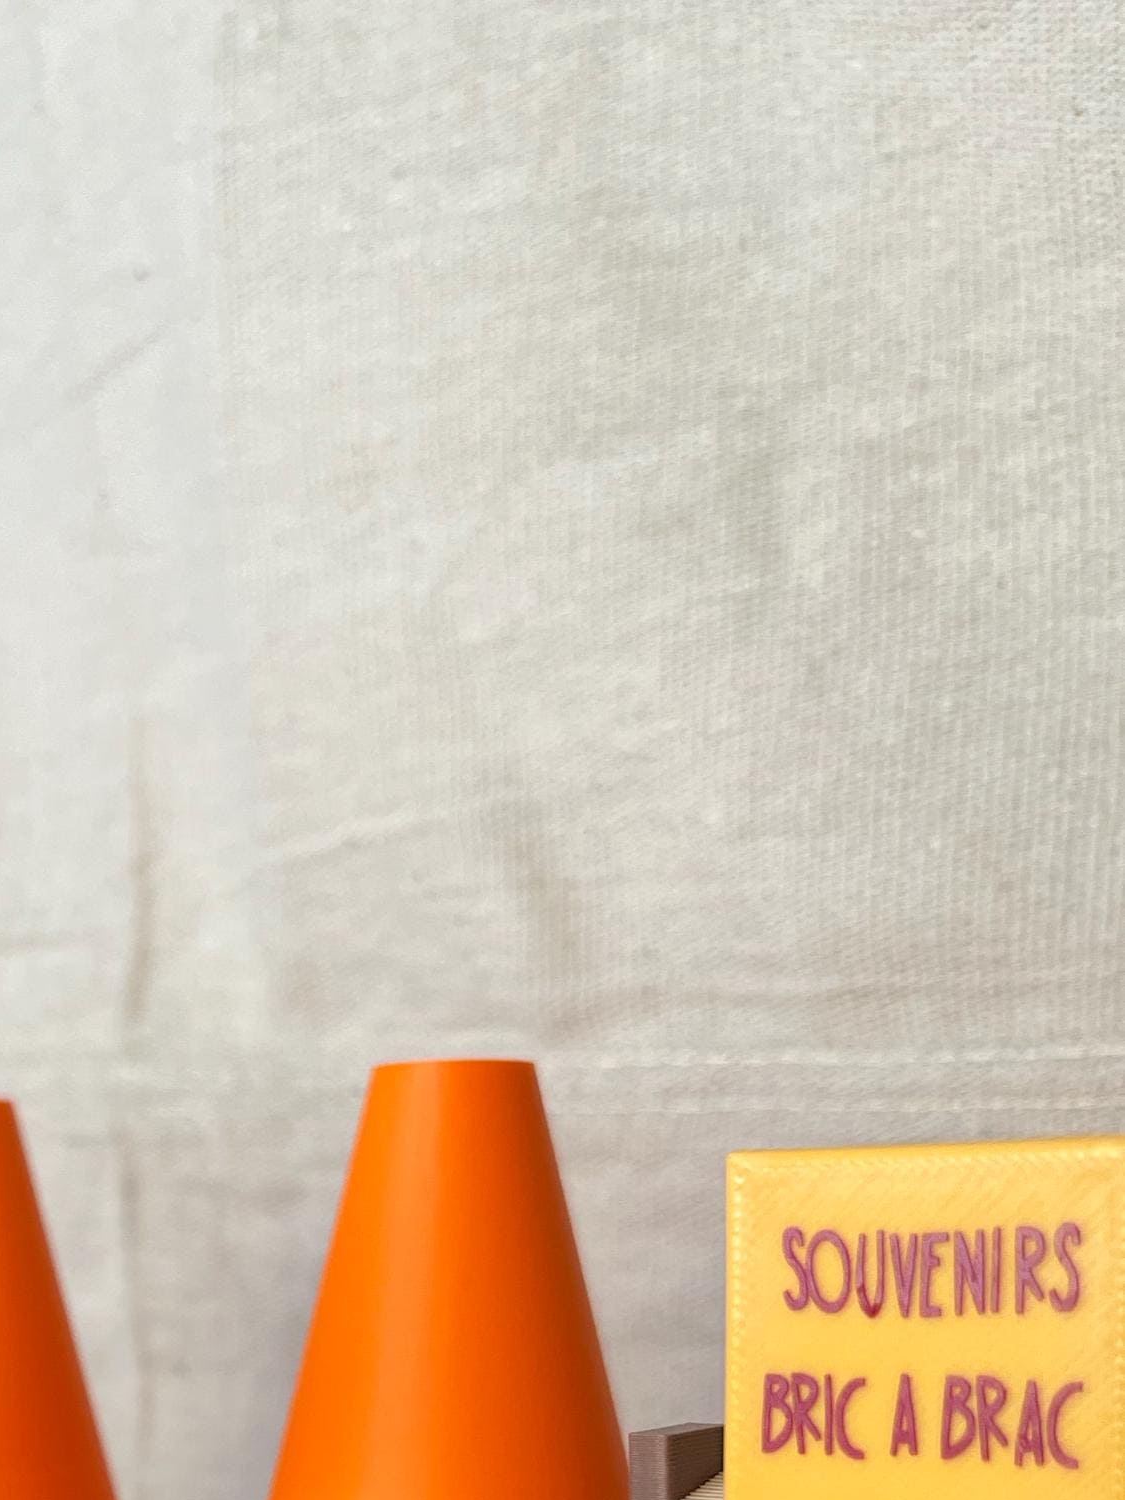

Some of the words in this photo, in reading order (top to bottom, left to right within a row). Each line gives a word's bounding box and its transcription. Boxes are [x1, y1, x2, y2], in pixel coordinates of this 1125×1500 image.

[782, 1222, 1082, 1318] SOUVENIRS
[761, 1372, 866, 1460] BRIC
[889, 1373, 919, 1457] A
[940, 1374, 1084, 1470] BRAC
